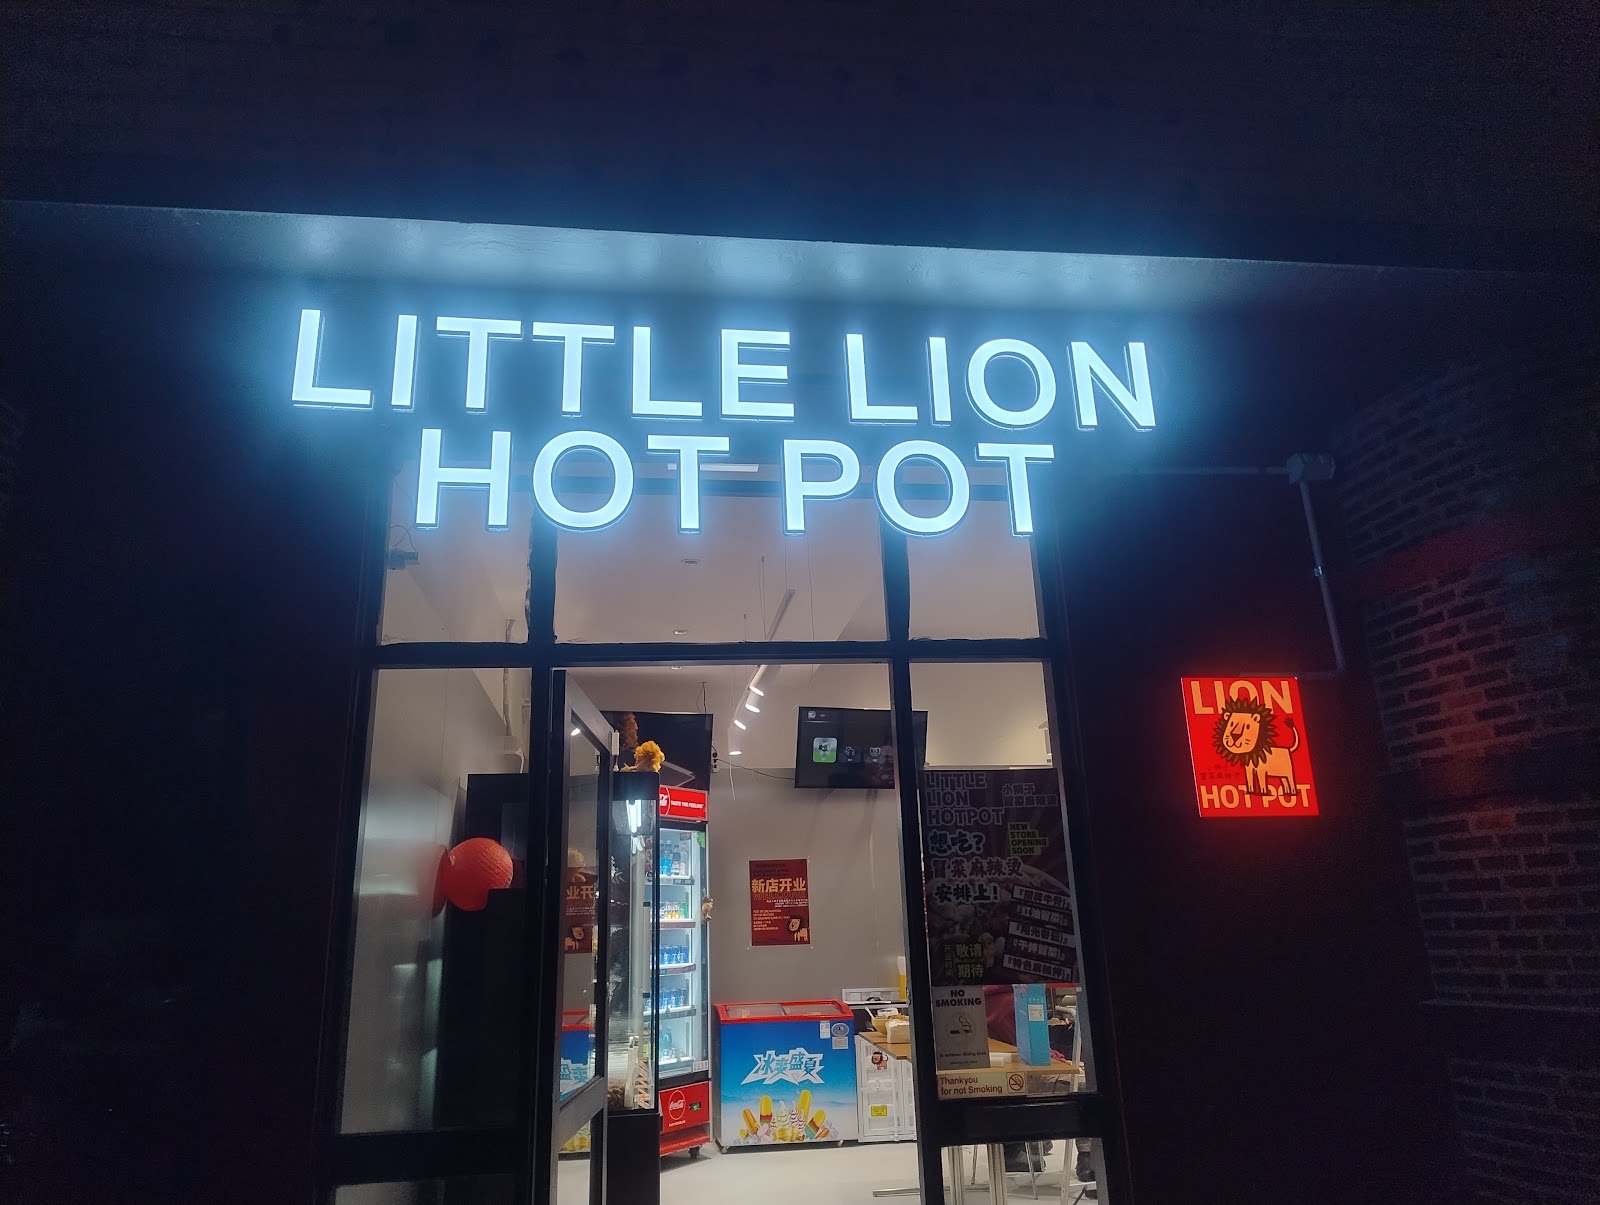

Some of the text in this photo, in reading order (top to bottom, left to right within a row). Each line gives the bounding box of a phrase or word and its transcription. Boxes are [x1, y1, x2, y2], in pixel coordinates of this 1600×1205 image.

[292, 309, 1156, 428] LITTLE LION
[415, 428, 1055, 535] HOT POT
[1190, 680, 1293, 714] LION
[924, 771, 987, 790] LITTLE
[925, 789, 970, 808] LION
[1200, 784, 1311, 809] HOT POT
[926, 807, 1004, 826] HOTPOT
[1010, 823, 1028, 831] NEW
[1010, 831, 1037, 839] STORE
[1011, 838, 1047, 846] OPENING
[1012, 846, 1035, 855] SOON
[931, 858, 1024, 879] 冒菜麻辣烫
[752, 877, 806, 893] 新店开业
[956, 943, 983, 958] 敬请
[957, 963, 984, 978] 期待
[950, 989, 965, 997] NO
[935, 997, 982, 1008] SMOKING
[755, 1051, 818, 1075] 冰爽盛夏
[940, 1077, 978, 1087] Thankyou
[941, 1084, 1003, 1095] for not Smoking
